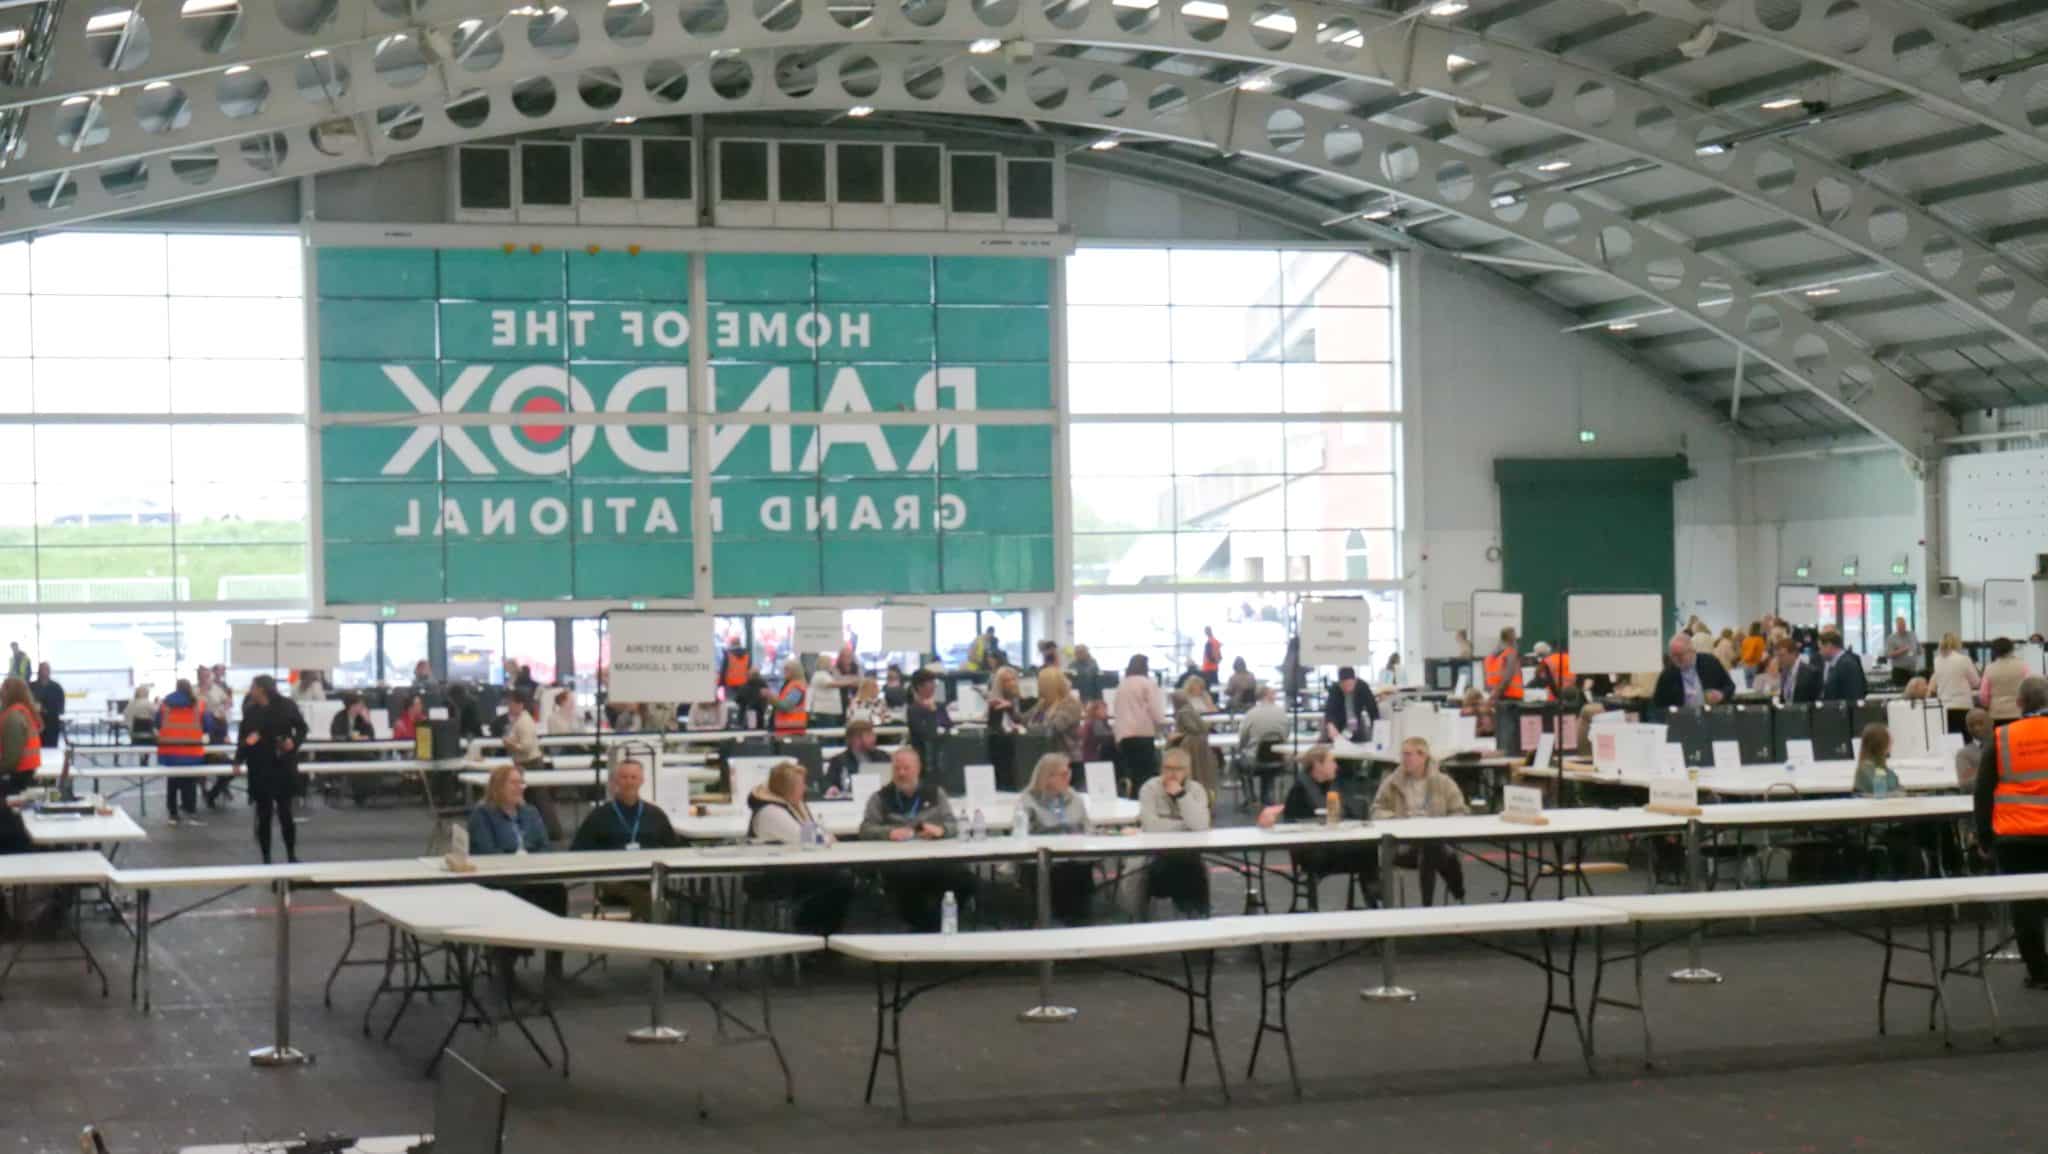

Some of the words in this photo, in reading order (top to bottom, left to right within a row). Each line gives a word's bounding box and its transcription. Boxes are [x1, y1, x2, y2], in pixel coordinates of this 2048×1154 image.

[625, 644, 672, 653] AINTREE
[676, 644, 699, 653] AND
[672, 663, 710, 672] SOUTH
